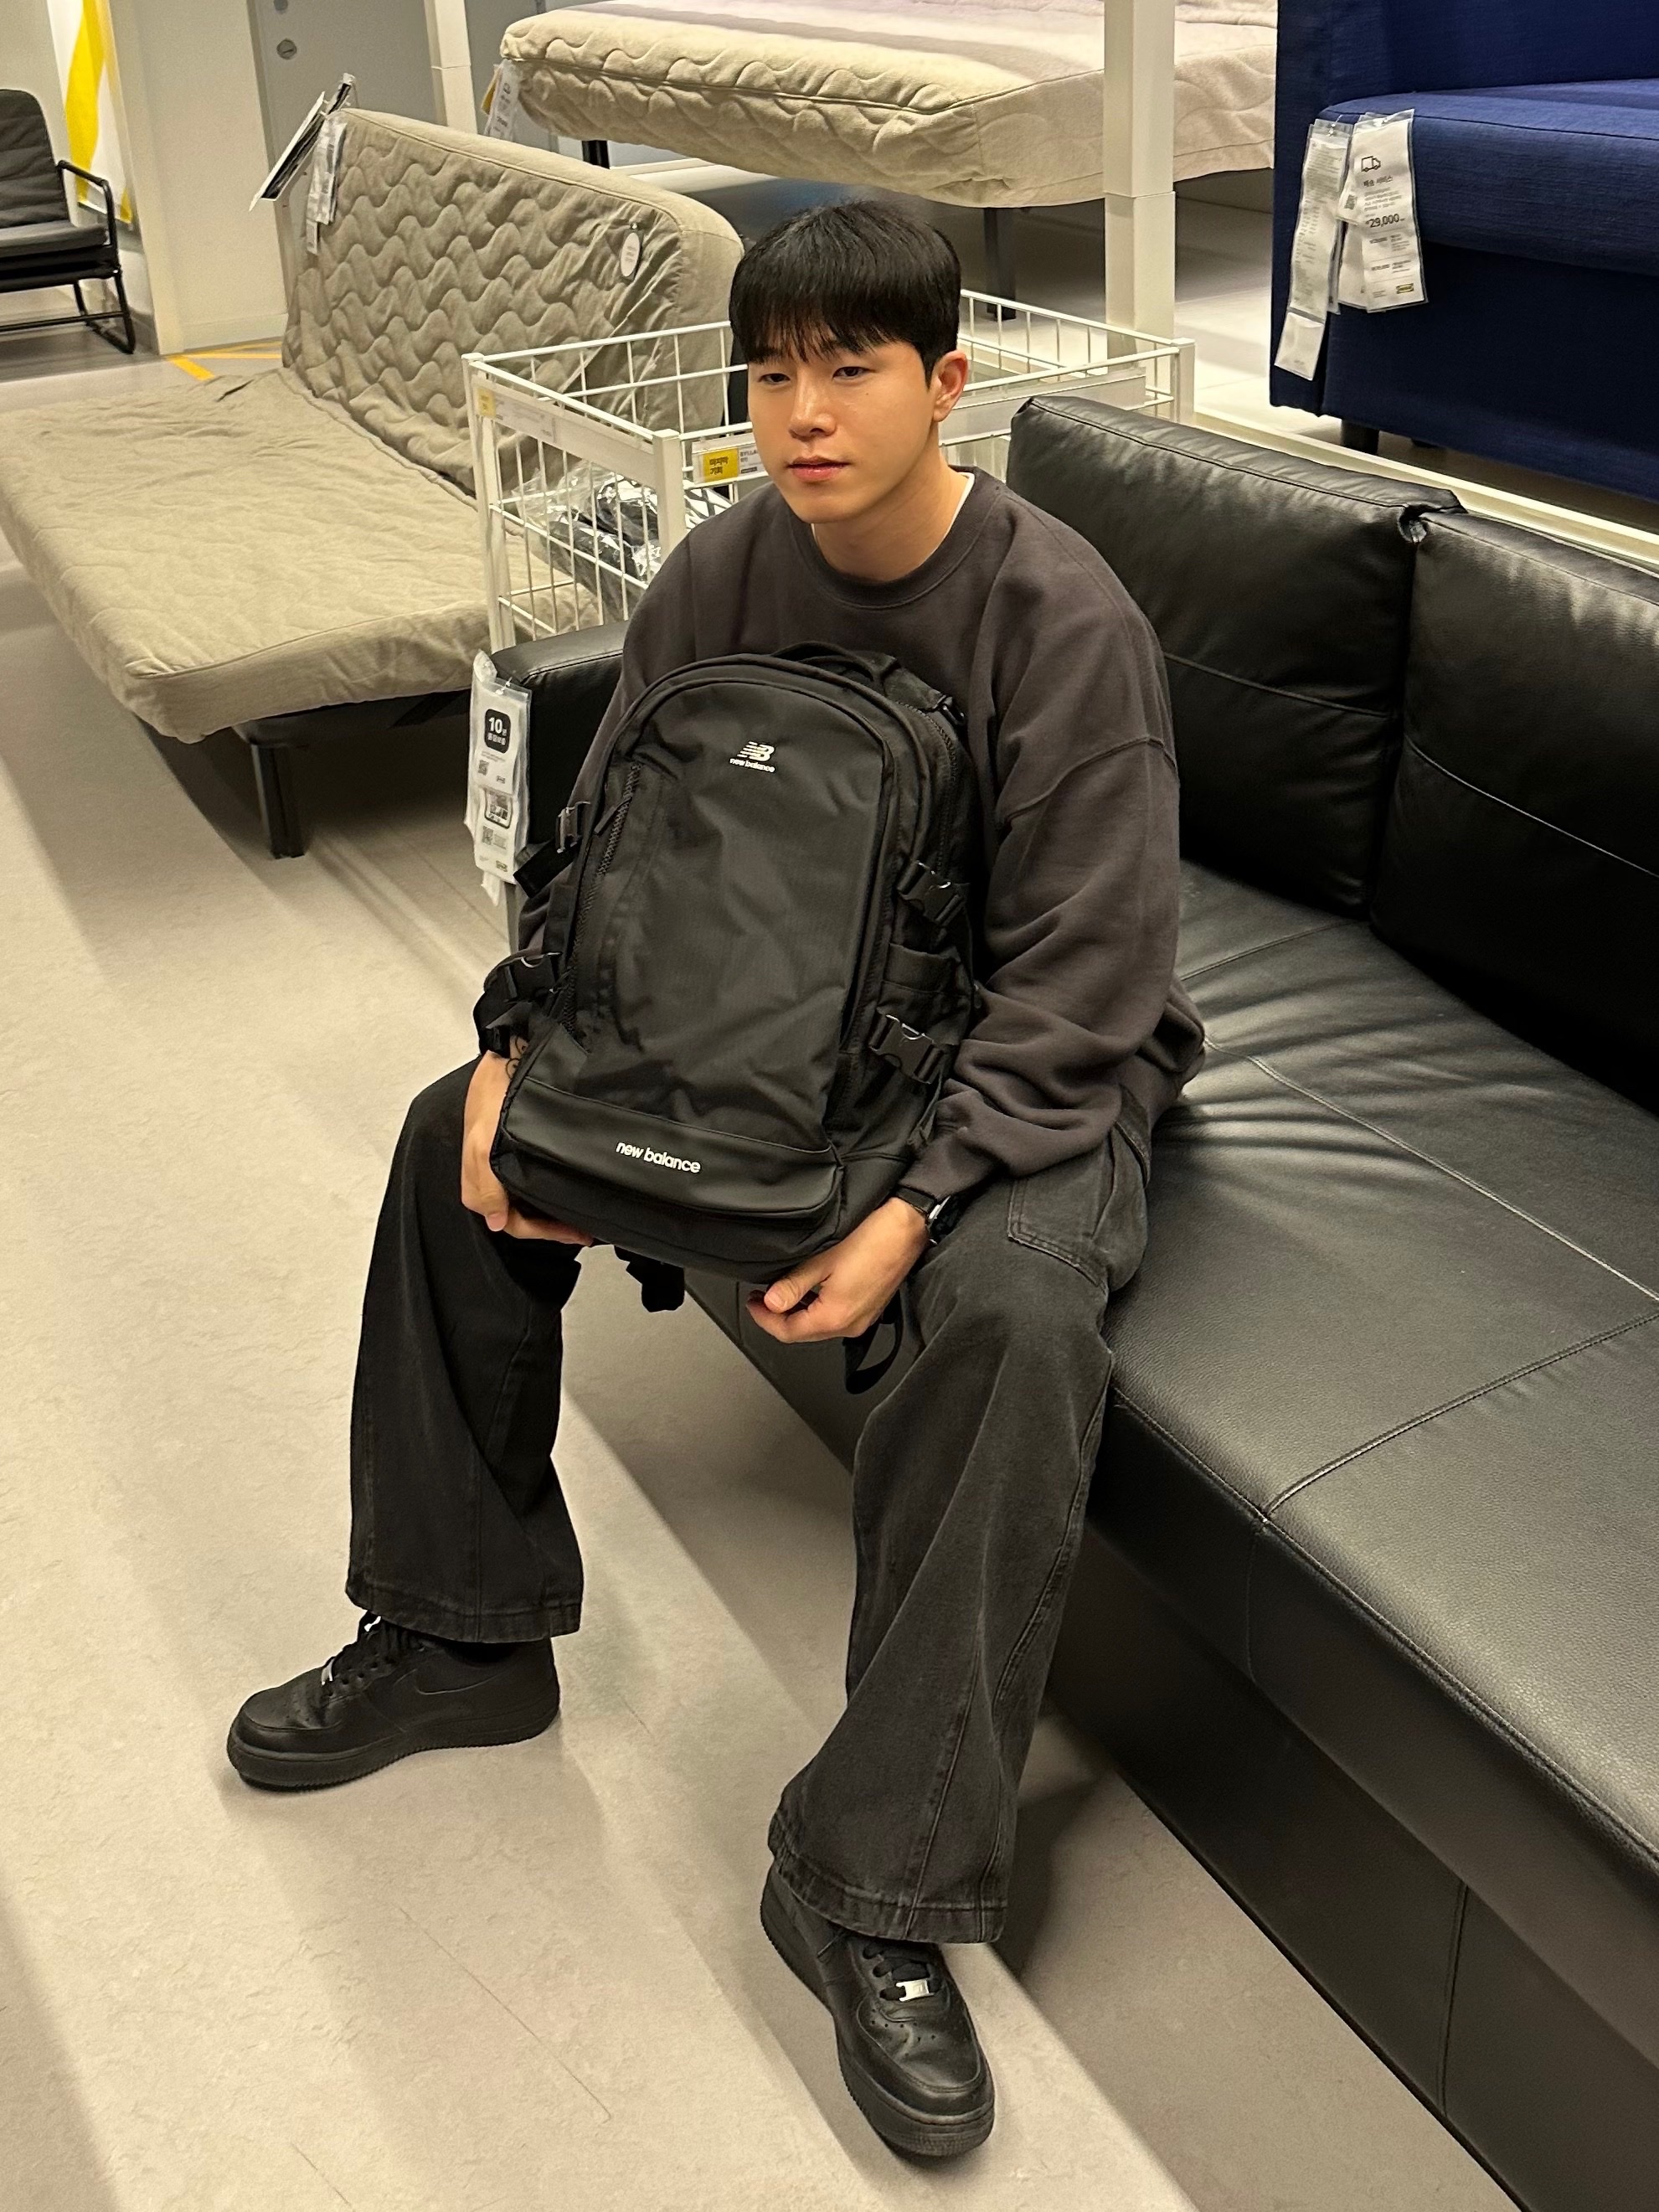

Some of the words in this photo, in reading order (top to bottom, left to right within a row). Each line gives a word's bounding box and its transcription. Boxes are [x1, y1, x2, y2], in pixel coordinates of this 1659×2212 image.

[744, 760, 775, 773] balance
[616, 1142, 644, 1158] new
[643, 1147, 701, 1173] balance
